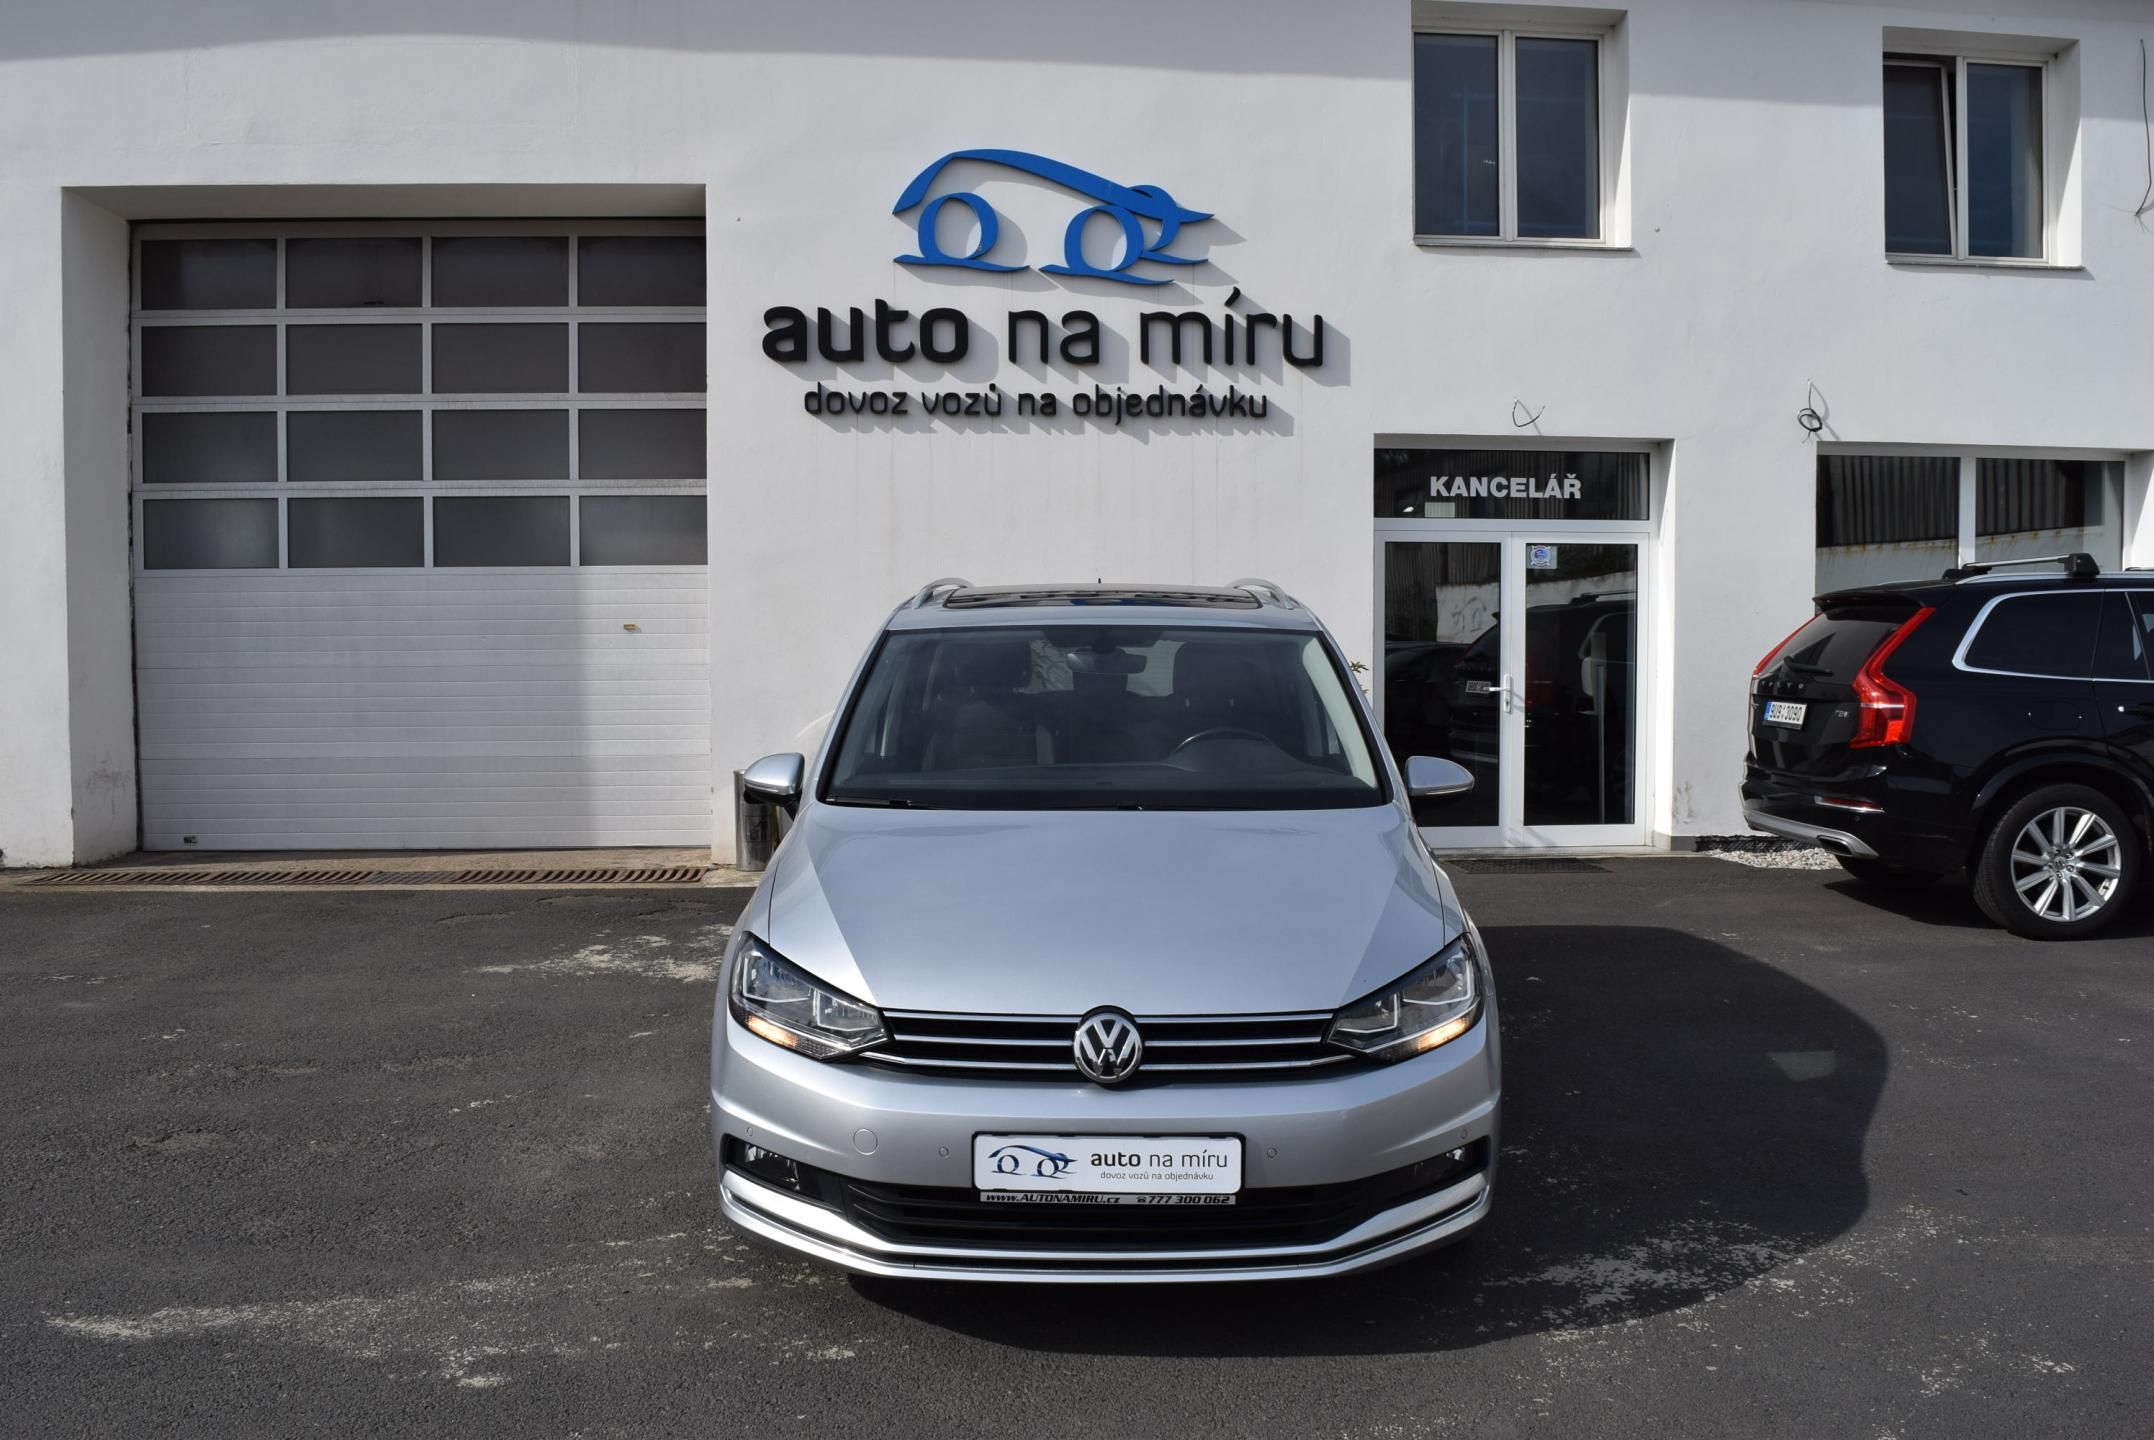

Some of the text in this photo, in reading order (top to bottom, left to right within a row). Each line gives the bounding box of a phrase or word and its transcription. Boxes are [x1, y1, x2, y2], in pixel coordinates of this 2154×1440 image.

[762, 287, 1324, 367] auto na míru
[804, 382, 1268, 425] dovoz vozů na objednávku
[1430, 473, 1582, 499] KANCELÁŘ
[1090, 1149, 1228, 1168] auto na míru
[1100, 1171, 1126, 1180] dovoz
[1129, 1171, 1149, 1180] vozů
[1165, 1172, 1214, 1182] objednávku
[1175, 1195, 1201, 1204] 300
[1202, 1196, 1230, 1204] 062
